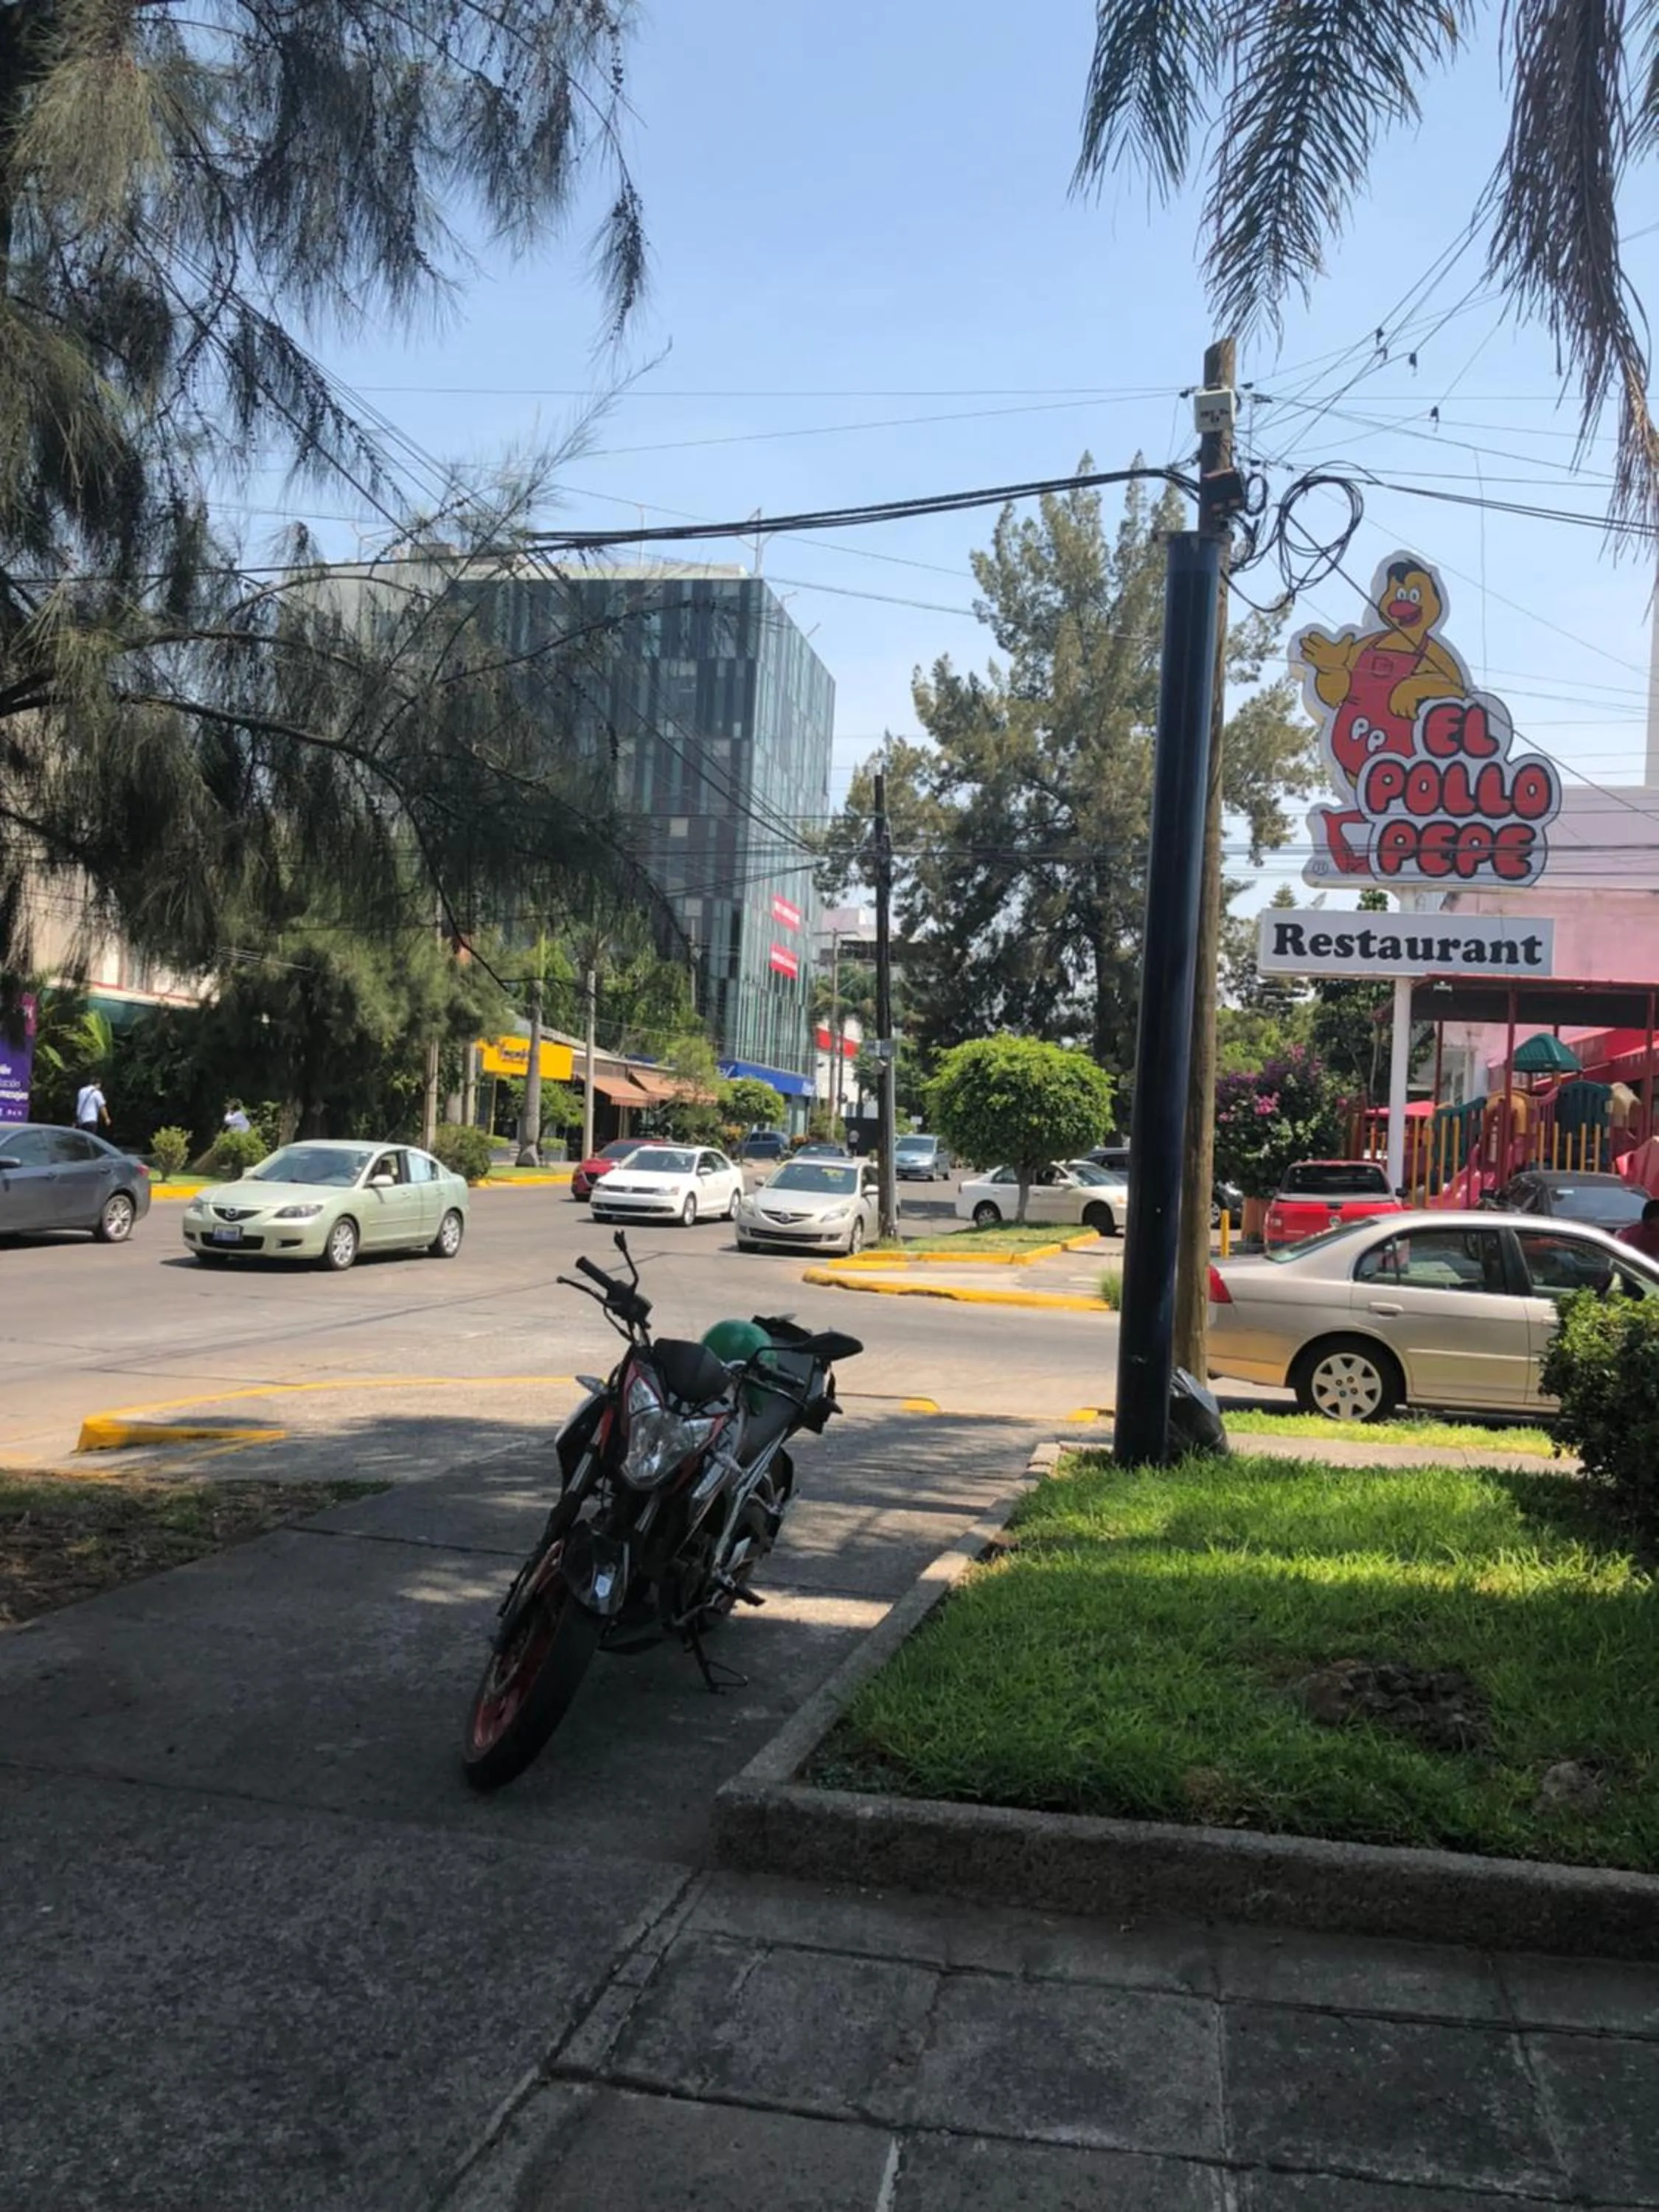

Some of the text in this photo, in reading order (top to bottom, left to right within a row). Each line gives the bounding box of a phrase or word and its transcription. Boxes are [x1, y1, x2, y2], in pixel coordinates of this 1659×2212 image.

[1423, 703, 1500, 758] EL
[1366, 759, 1552, 820] POLLO
[1377, 819, 1537, 880] PEPE
[1273, 923, 1543, 965] Restaurant
